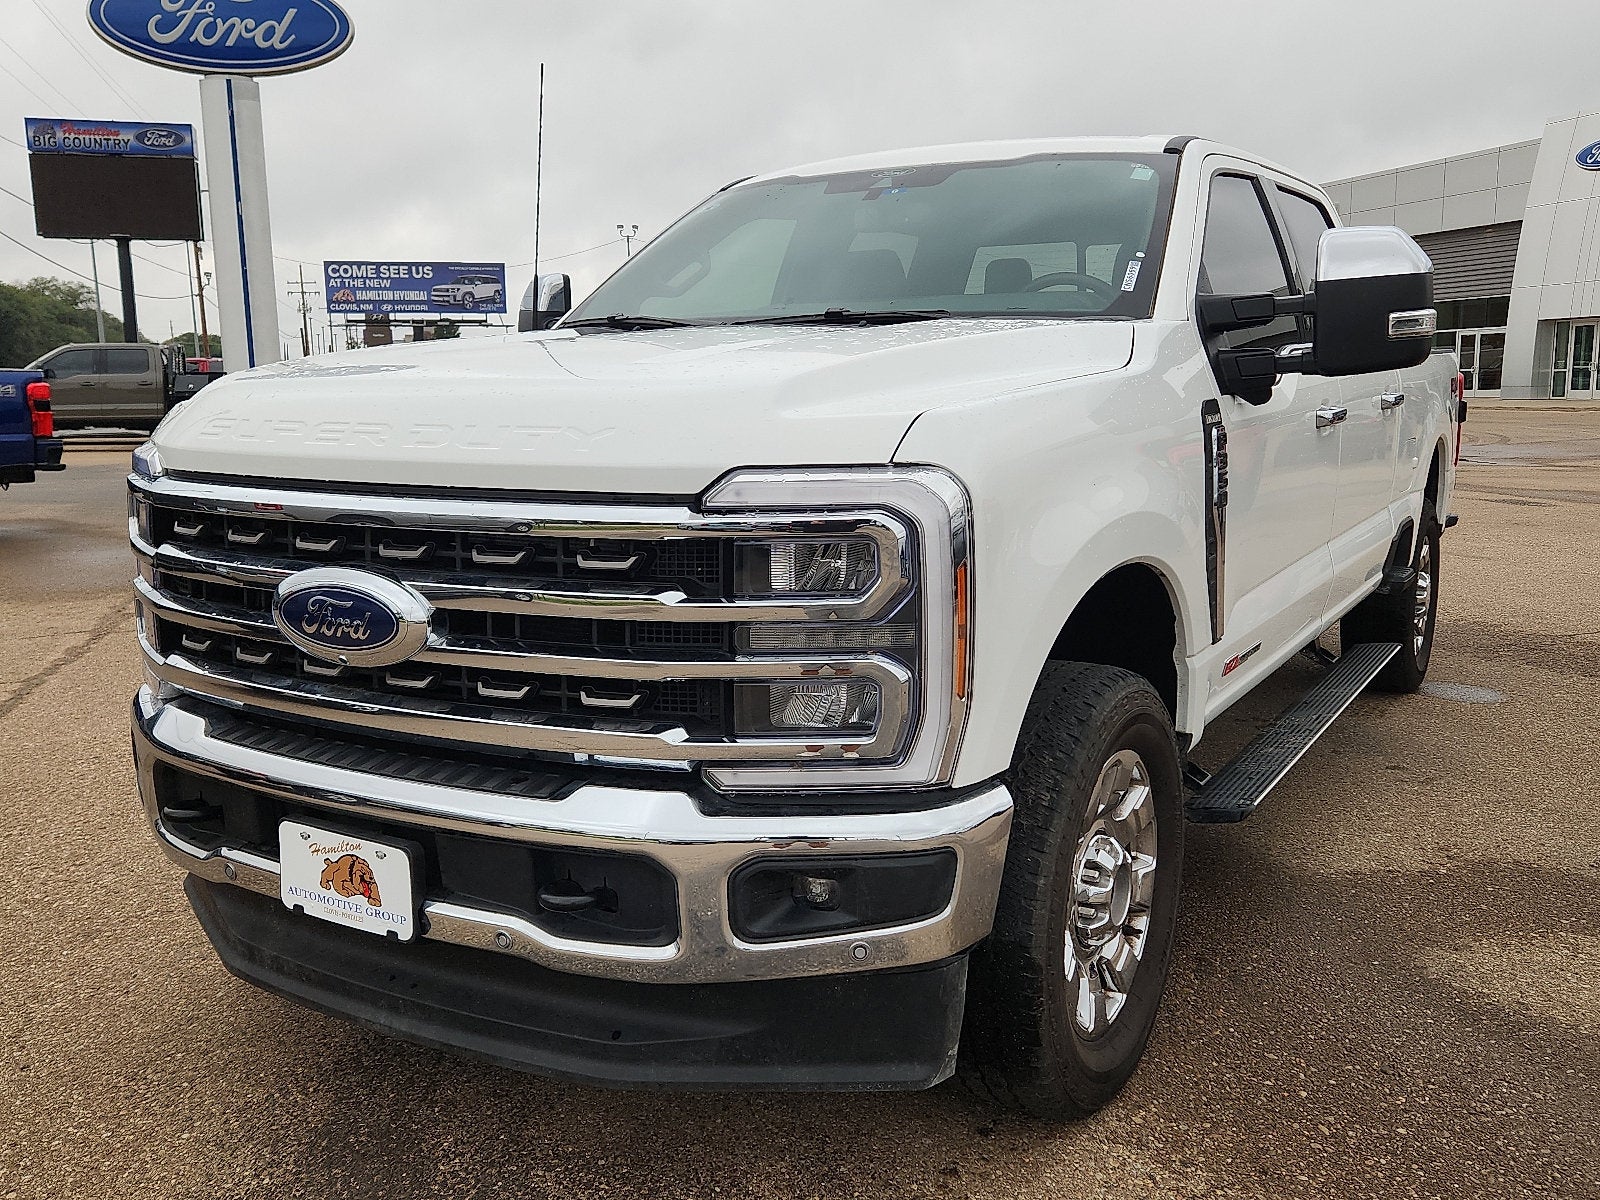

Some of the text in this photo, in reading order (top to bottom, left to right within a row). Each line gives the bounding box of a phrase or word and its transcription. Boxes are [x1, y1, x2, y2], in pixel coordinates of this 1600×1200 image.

[147, 0, 298, 50] Ford
[32, 135, 131, 151] BIG COUNTRY
[144, 130, 175, 146] Ford
[327, 264, 433, 279] COME SEE US
[328, 279, 391, 288] AT THE NEW
[356, 290, 428, 301] HAMILTON HYUNDAI
[329, 303, 359, 312] CLOVIS,
[394, 304, 429, 312] HYUNDAI
[199, 416, 617, 452] SUPER DUTY
[301, 595, 372, 641] Ford
[308, 840, 363, 857] Hamilton
[287, 885, 407, 926] AUTOMOTIVE GROUP
